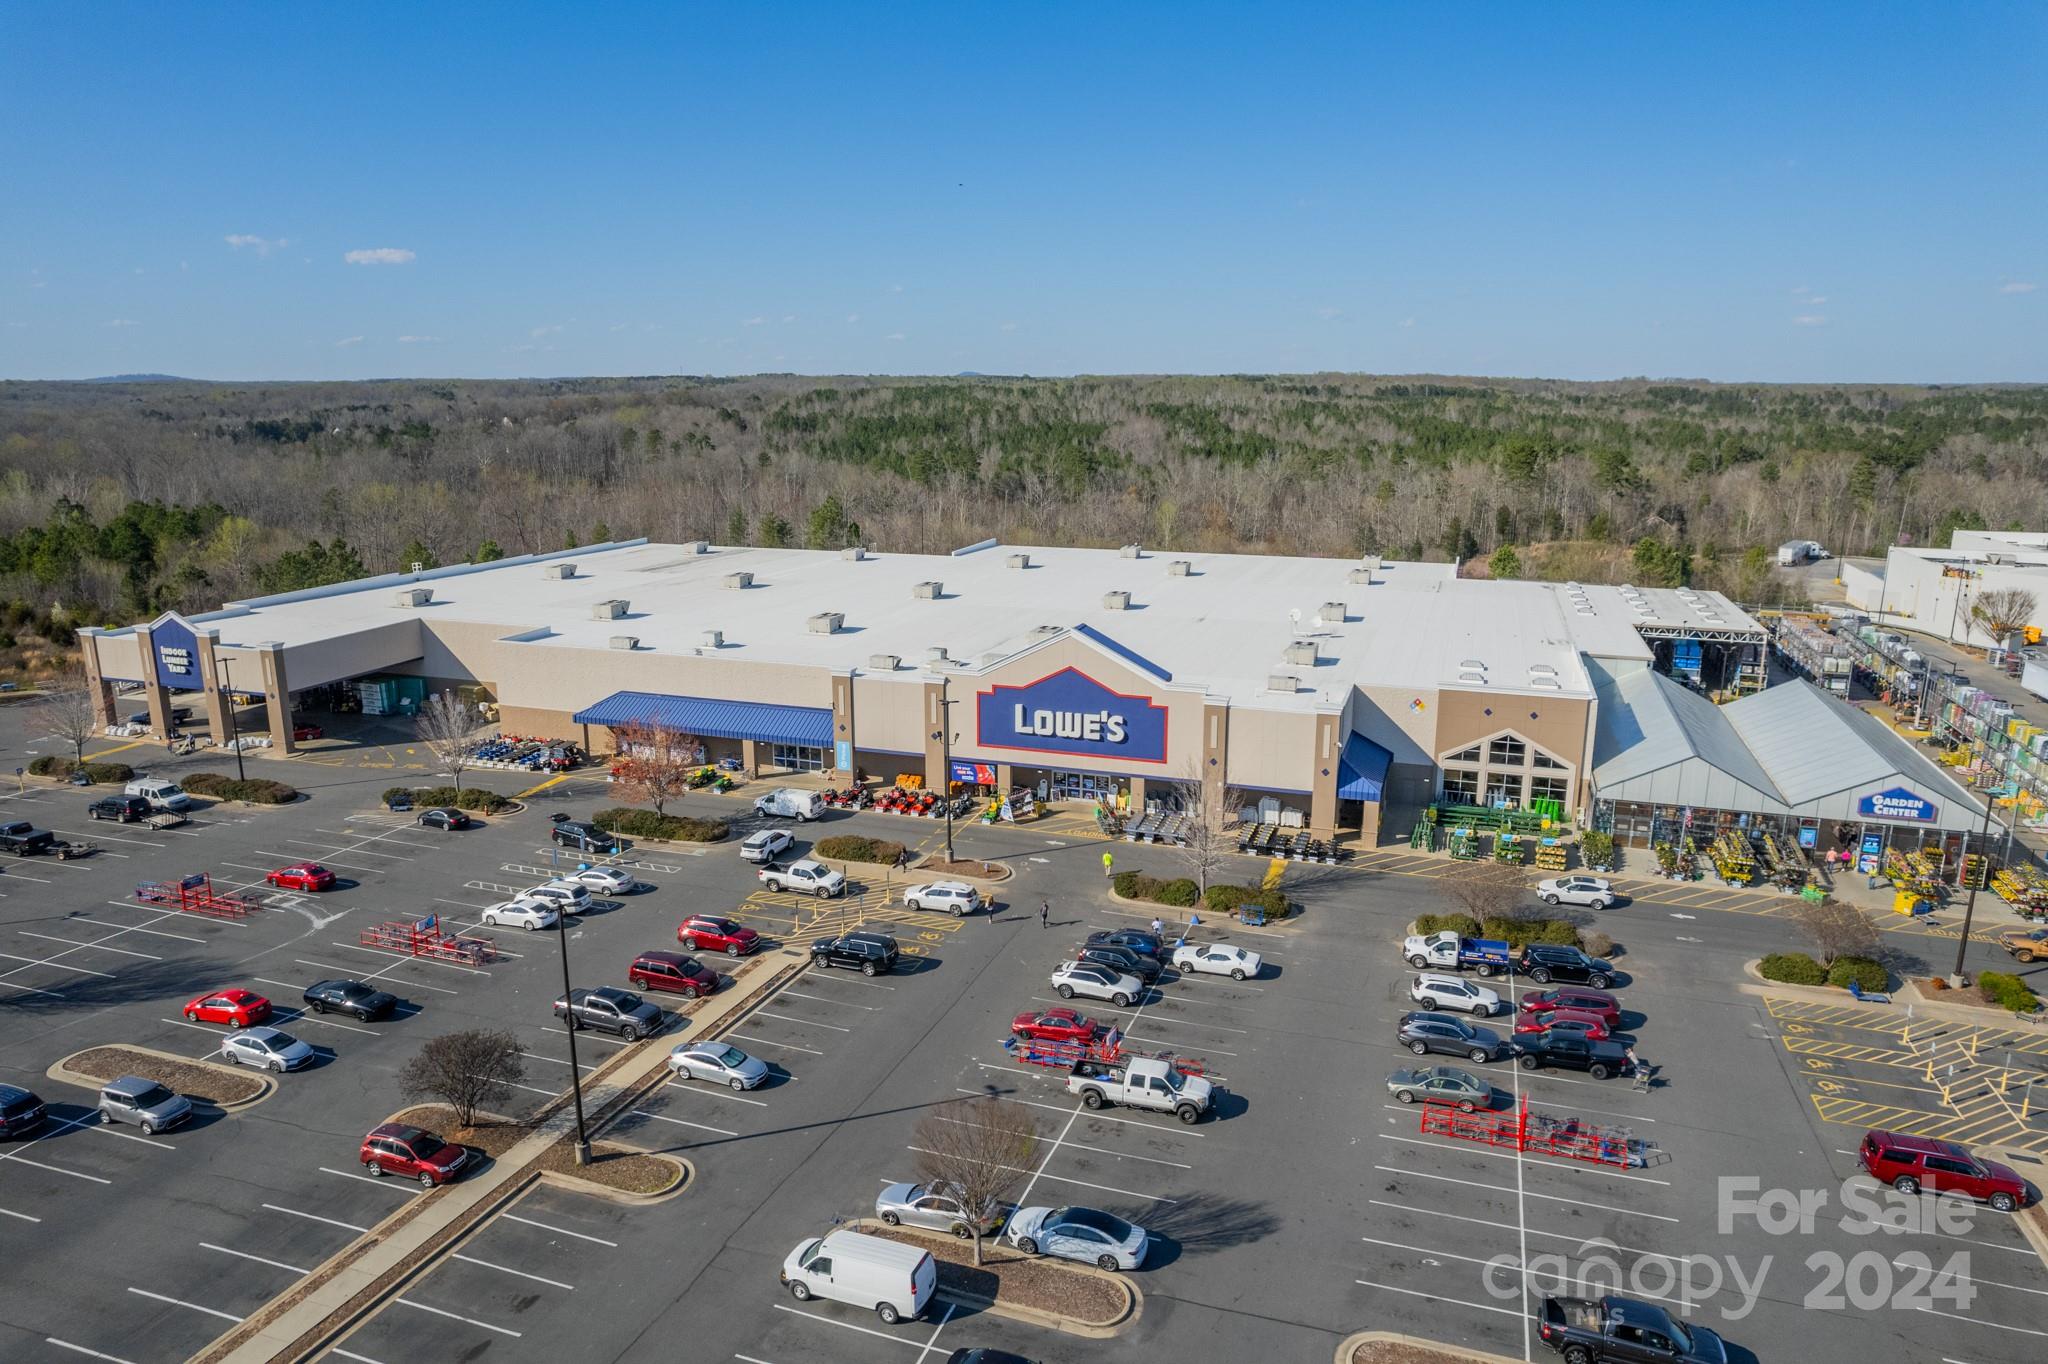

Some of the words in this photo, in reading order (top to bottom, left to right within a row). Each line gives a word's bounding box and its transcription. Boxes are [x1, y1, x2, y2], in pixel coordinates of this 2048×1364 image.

[160, 645, 187, 656] INDOOR
[167, 663, 186, 673] YARD
[1014, 703, 1126, 742] LOWE'S
[1872, 795, 1924, 809] GARDEN
[1873, 804, 1920, 818] CENTER
